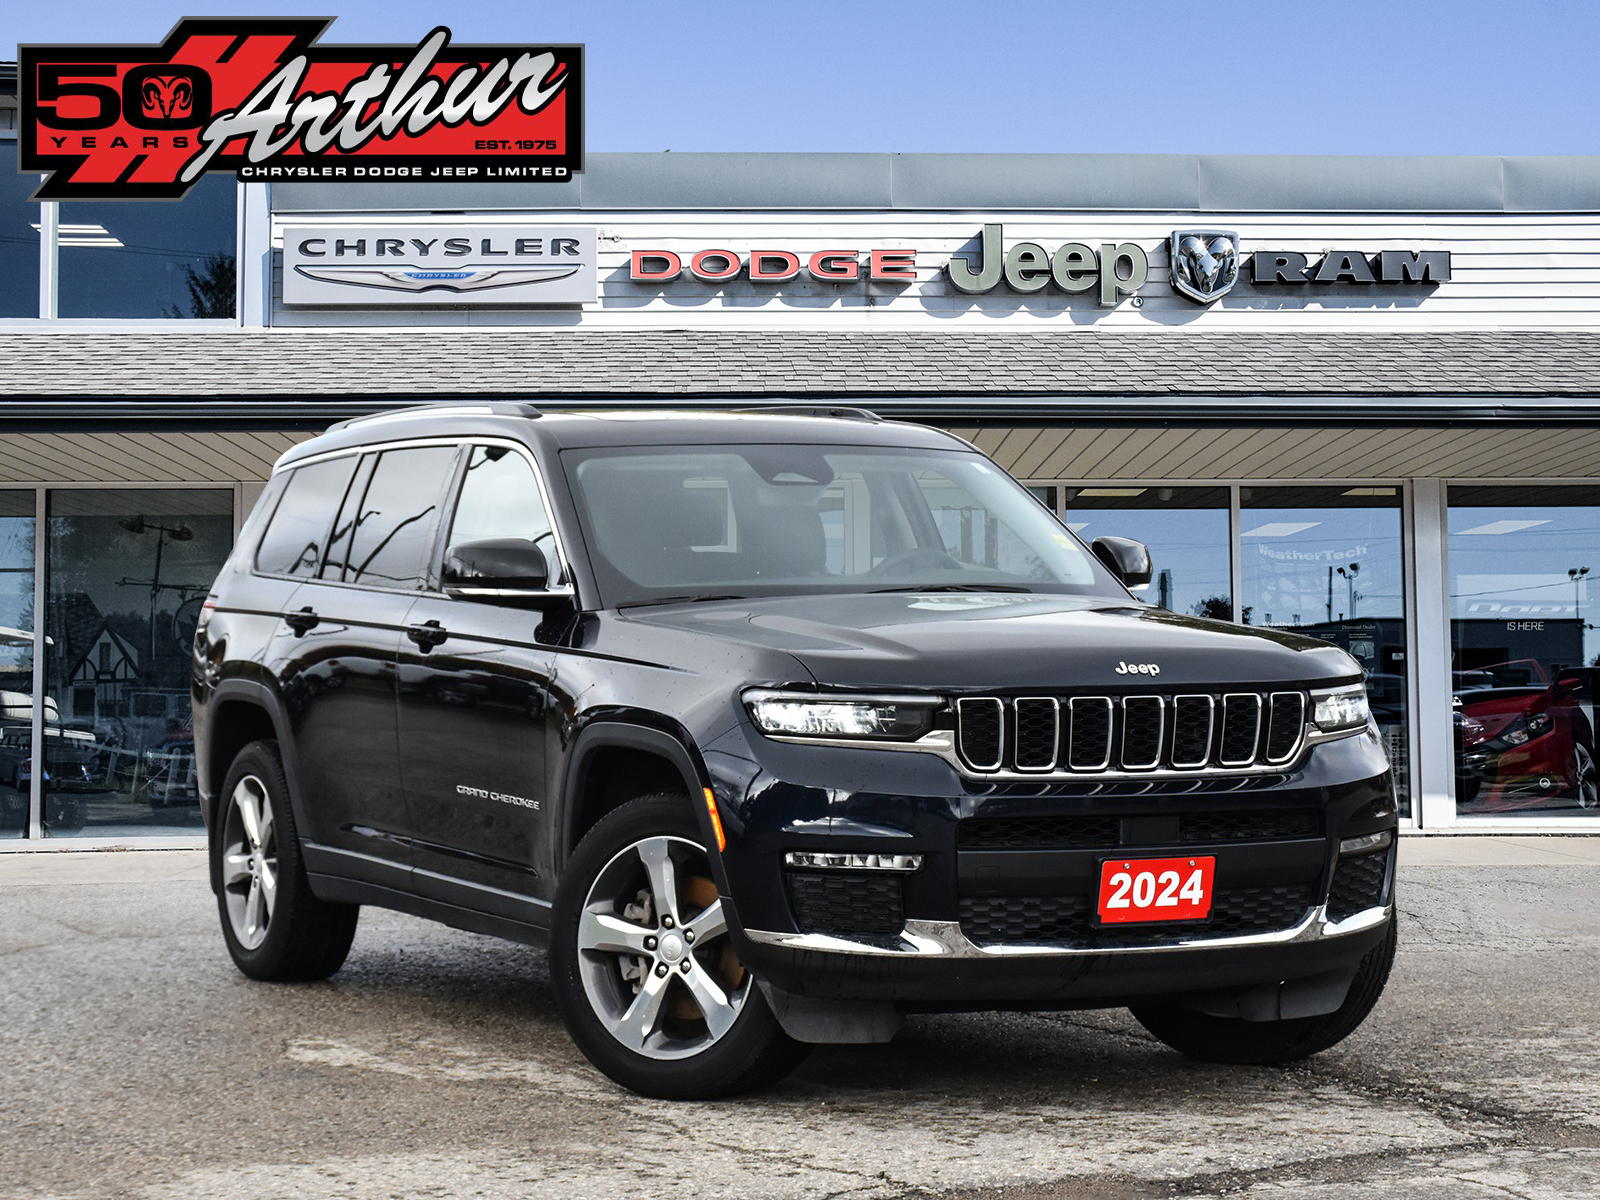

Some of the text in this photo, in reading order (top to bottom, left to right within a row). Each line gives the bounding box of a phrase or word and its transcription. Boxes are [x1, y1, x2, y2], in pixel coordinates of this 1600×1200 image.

[299, 237, 582, 257] CHRYSLER
[630, 249, 918, 283] DODGE
[948, 223, 1148, 306] Jeep
[1251, 250, 1452, 285] RAM
[1258, 543, 1367, 561] WeatherTech
[1507, 621, 1545, 631] IS HERE
[1115, 661, 1160, 676] Jeep
[456, 785, 540, 810] GRAND CHEROKEE
[1106, 869, 1204, 909] 2024
